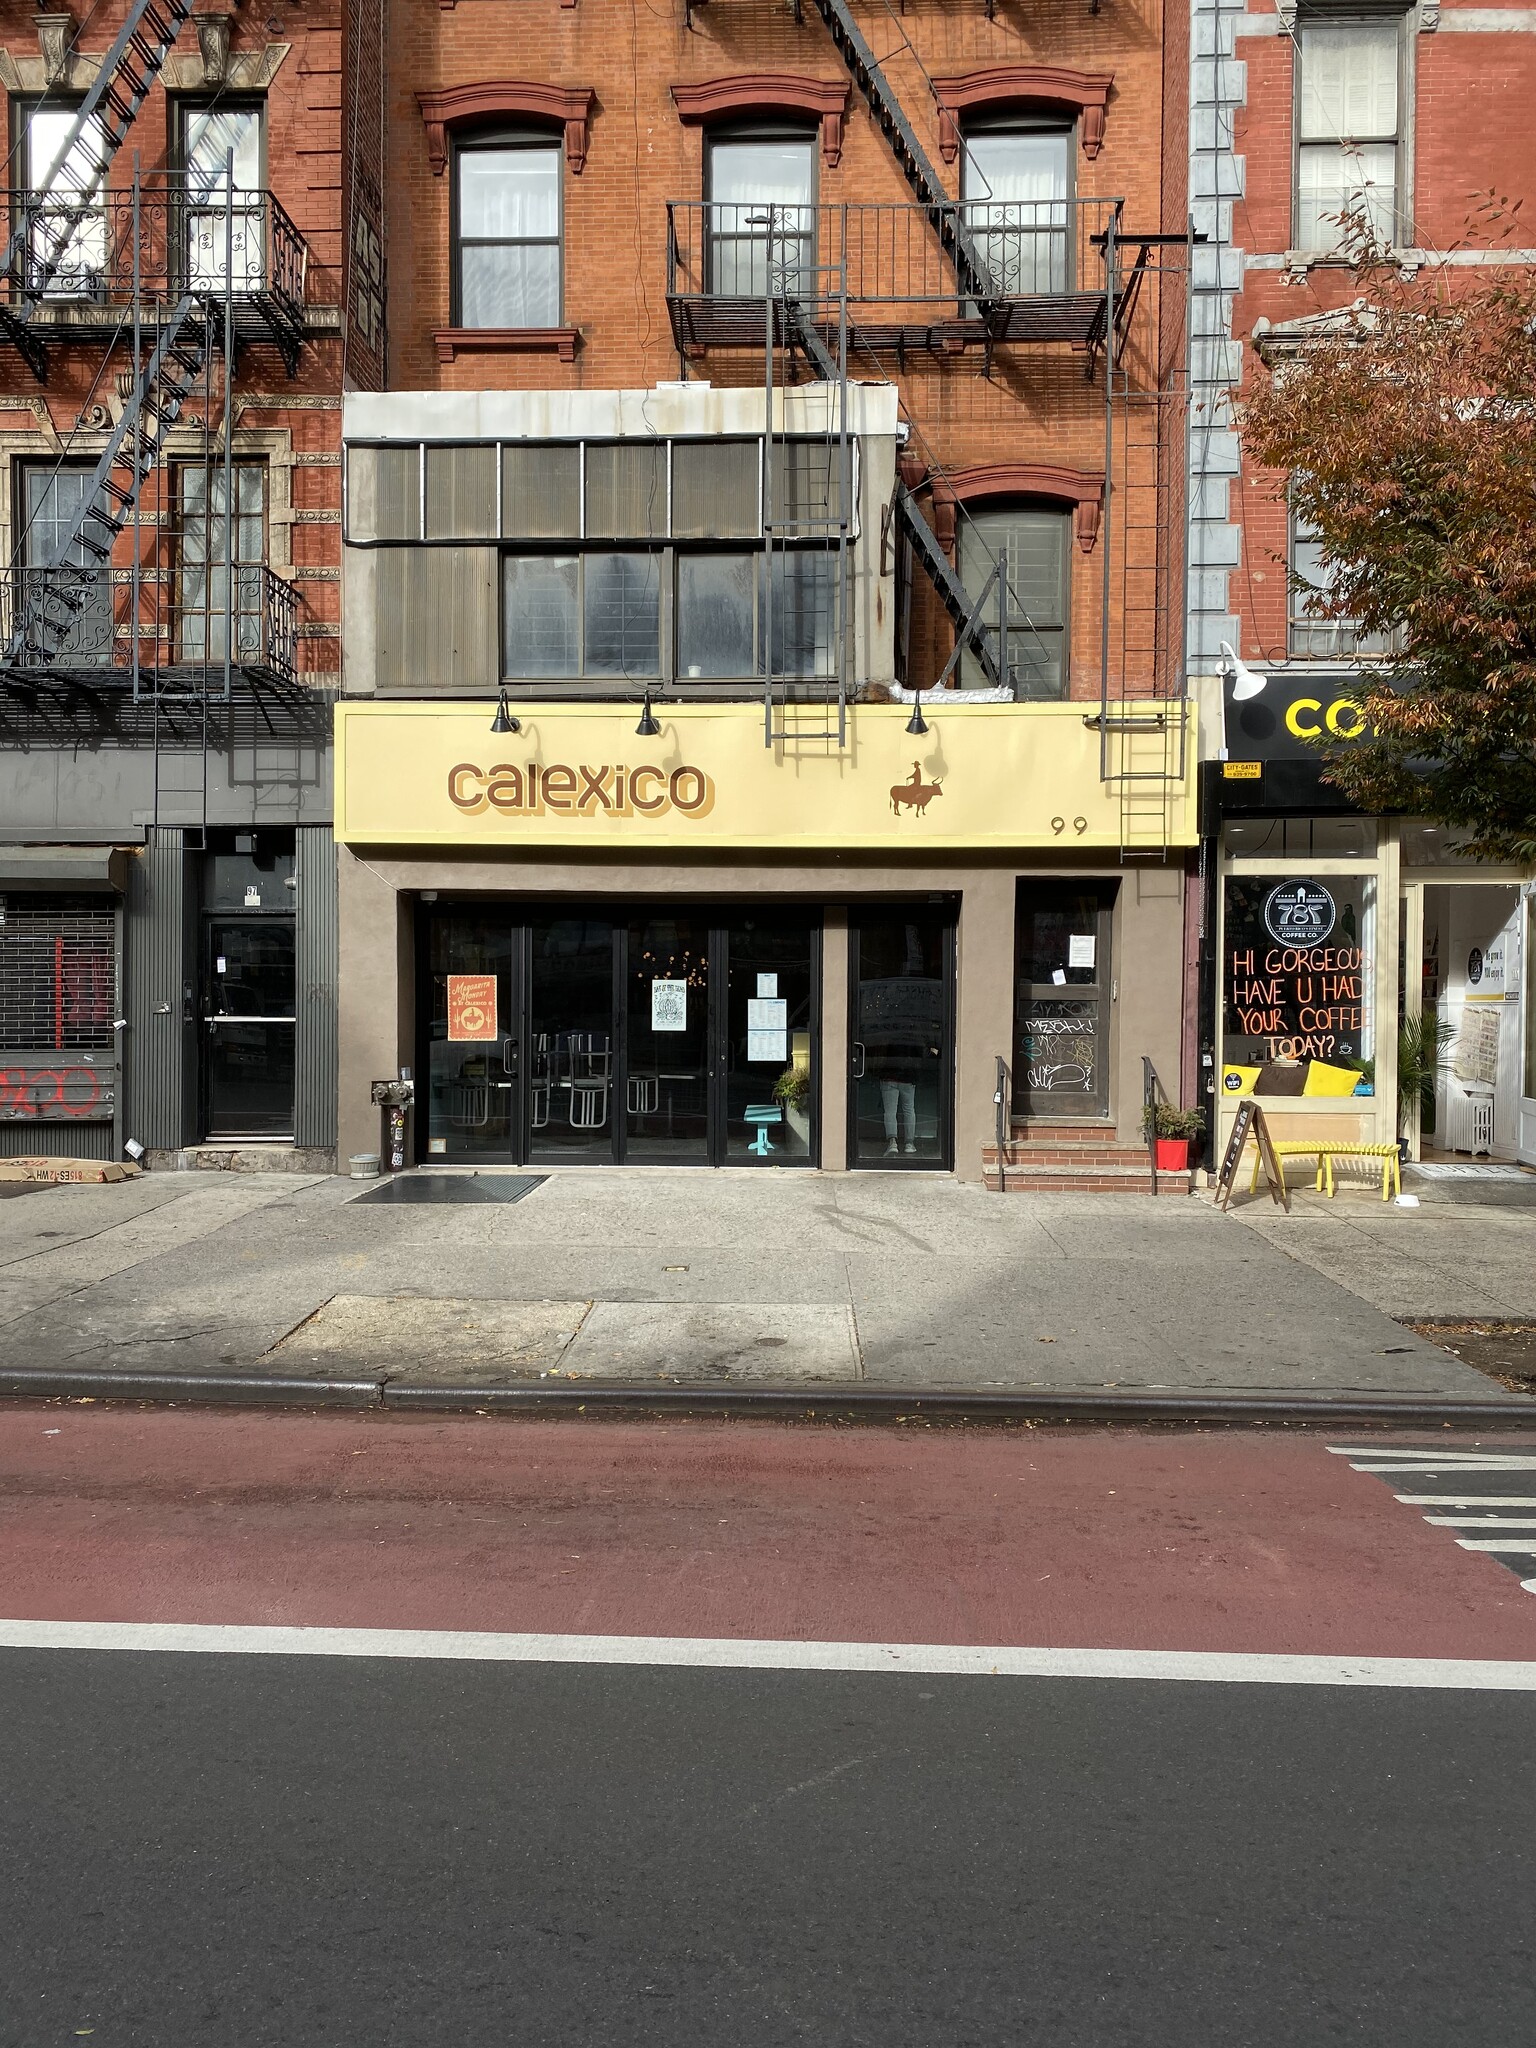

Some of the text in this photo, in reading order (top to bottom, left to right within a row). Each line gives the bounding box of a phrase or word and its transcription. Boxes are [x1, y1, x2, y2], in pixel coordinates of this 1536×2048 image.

[1285, 698, 1379, 738] CO
[447, 762, 715, 819] calexico
[1051, 816, 1088, 835] 99
[247, 887, 257, 895] 97
[1277, 904, 1323, 925] 787
[1233, 949, 1255, 976] HI
[1233, 975, 1365, 1004] HAVE U HAD
[1237, 1006, 1373, 1034] YOUR COFFEE
[1263, 1035, 1335, 1059] TODAY?
